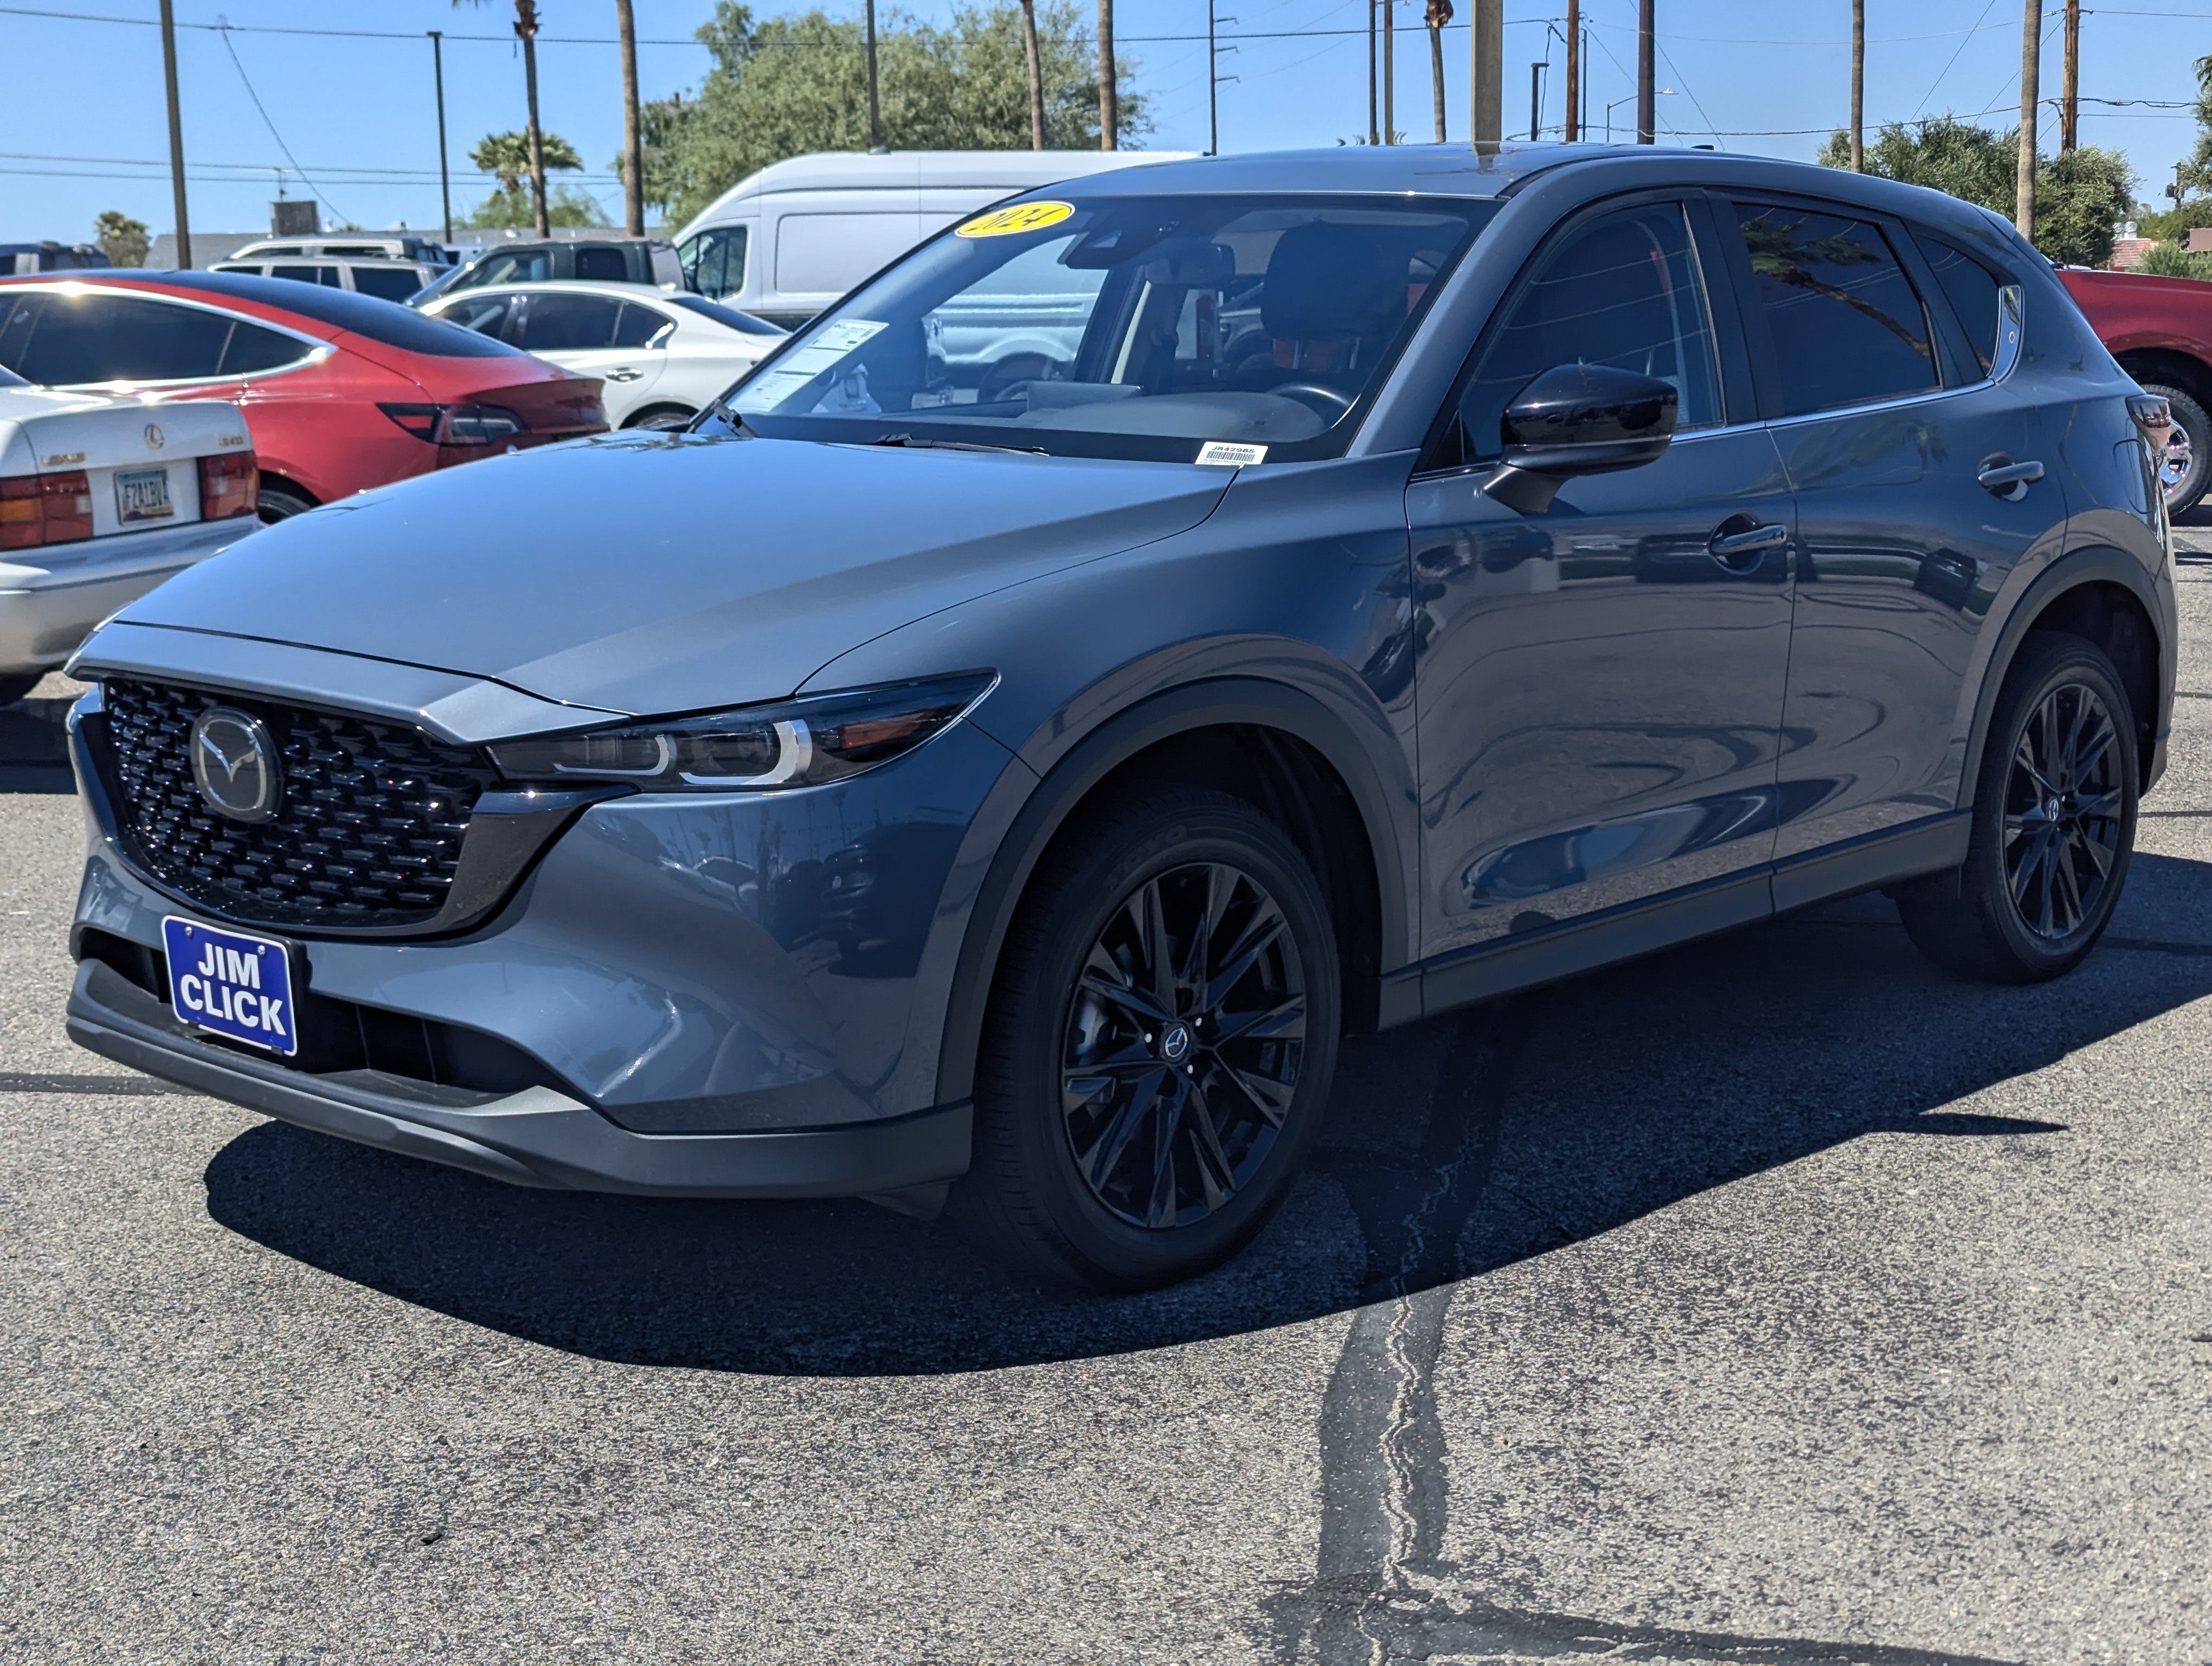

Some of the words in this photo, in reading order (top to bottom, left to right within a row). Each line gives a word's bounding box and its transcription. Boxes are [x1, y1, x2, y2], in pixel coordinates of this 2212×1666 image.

[963, 207, 1064, 232] 2024
[197, 942, 261, 989] JIM
[180, 974, 287, 1036] CLICK
